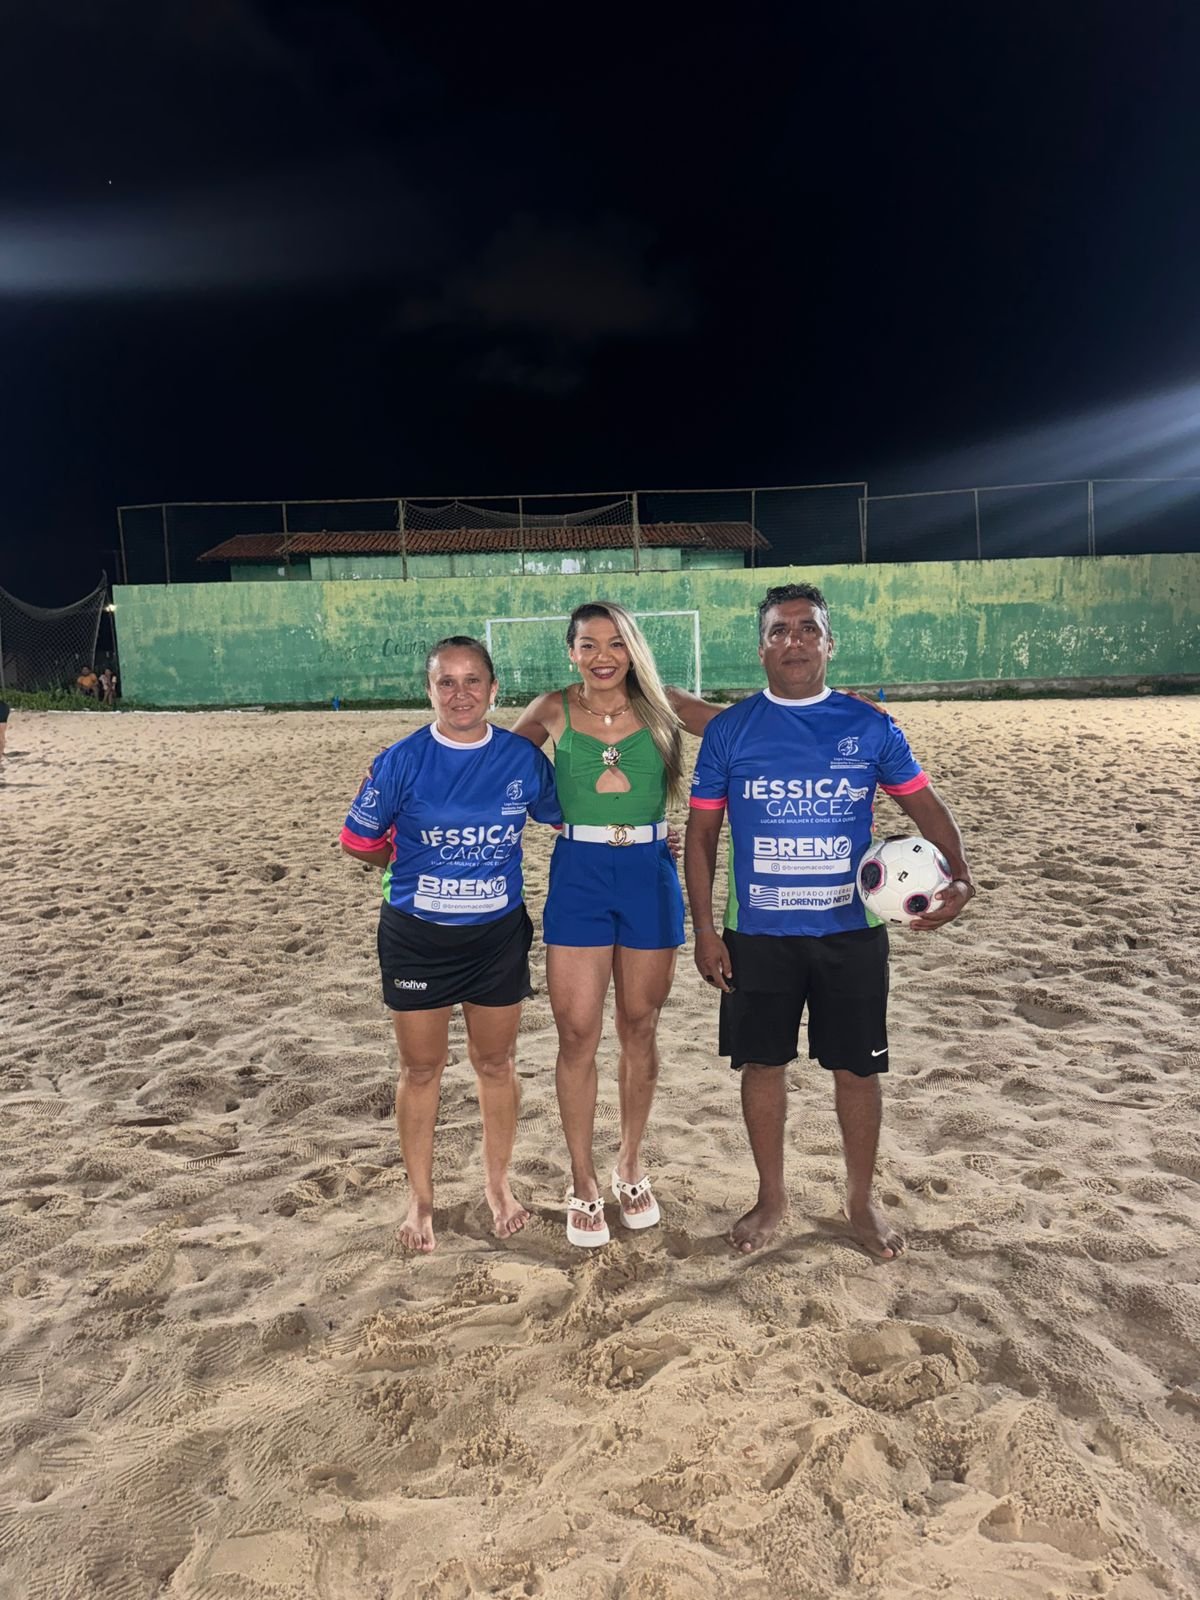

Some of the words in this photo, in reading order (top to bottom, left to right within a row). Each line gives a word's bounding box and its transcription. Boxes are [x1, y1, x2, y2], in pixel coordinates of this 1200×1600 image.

[742, 776, 851, 799] JÉSSICA
[766, 799, 854, 817] GARCEZ
[420, 824, 515, 847] JÉSSICA
[440, 844, 512, 860] GARCEZ
[753, 836, 852, 859] BRENO
[417, 875, 507, 899] BRENO
[781, 897, 832, 907] FLORENTINO
[832, 894, 850, 904] NETO
